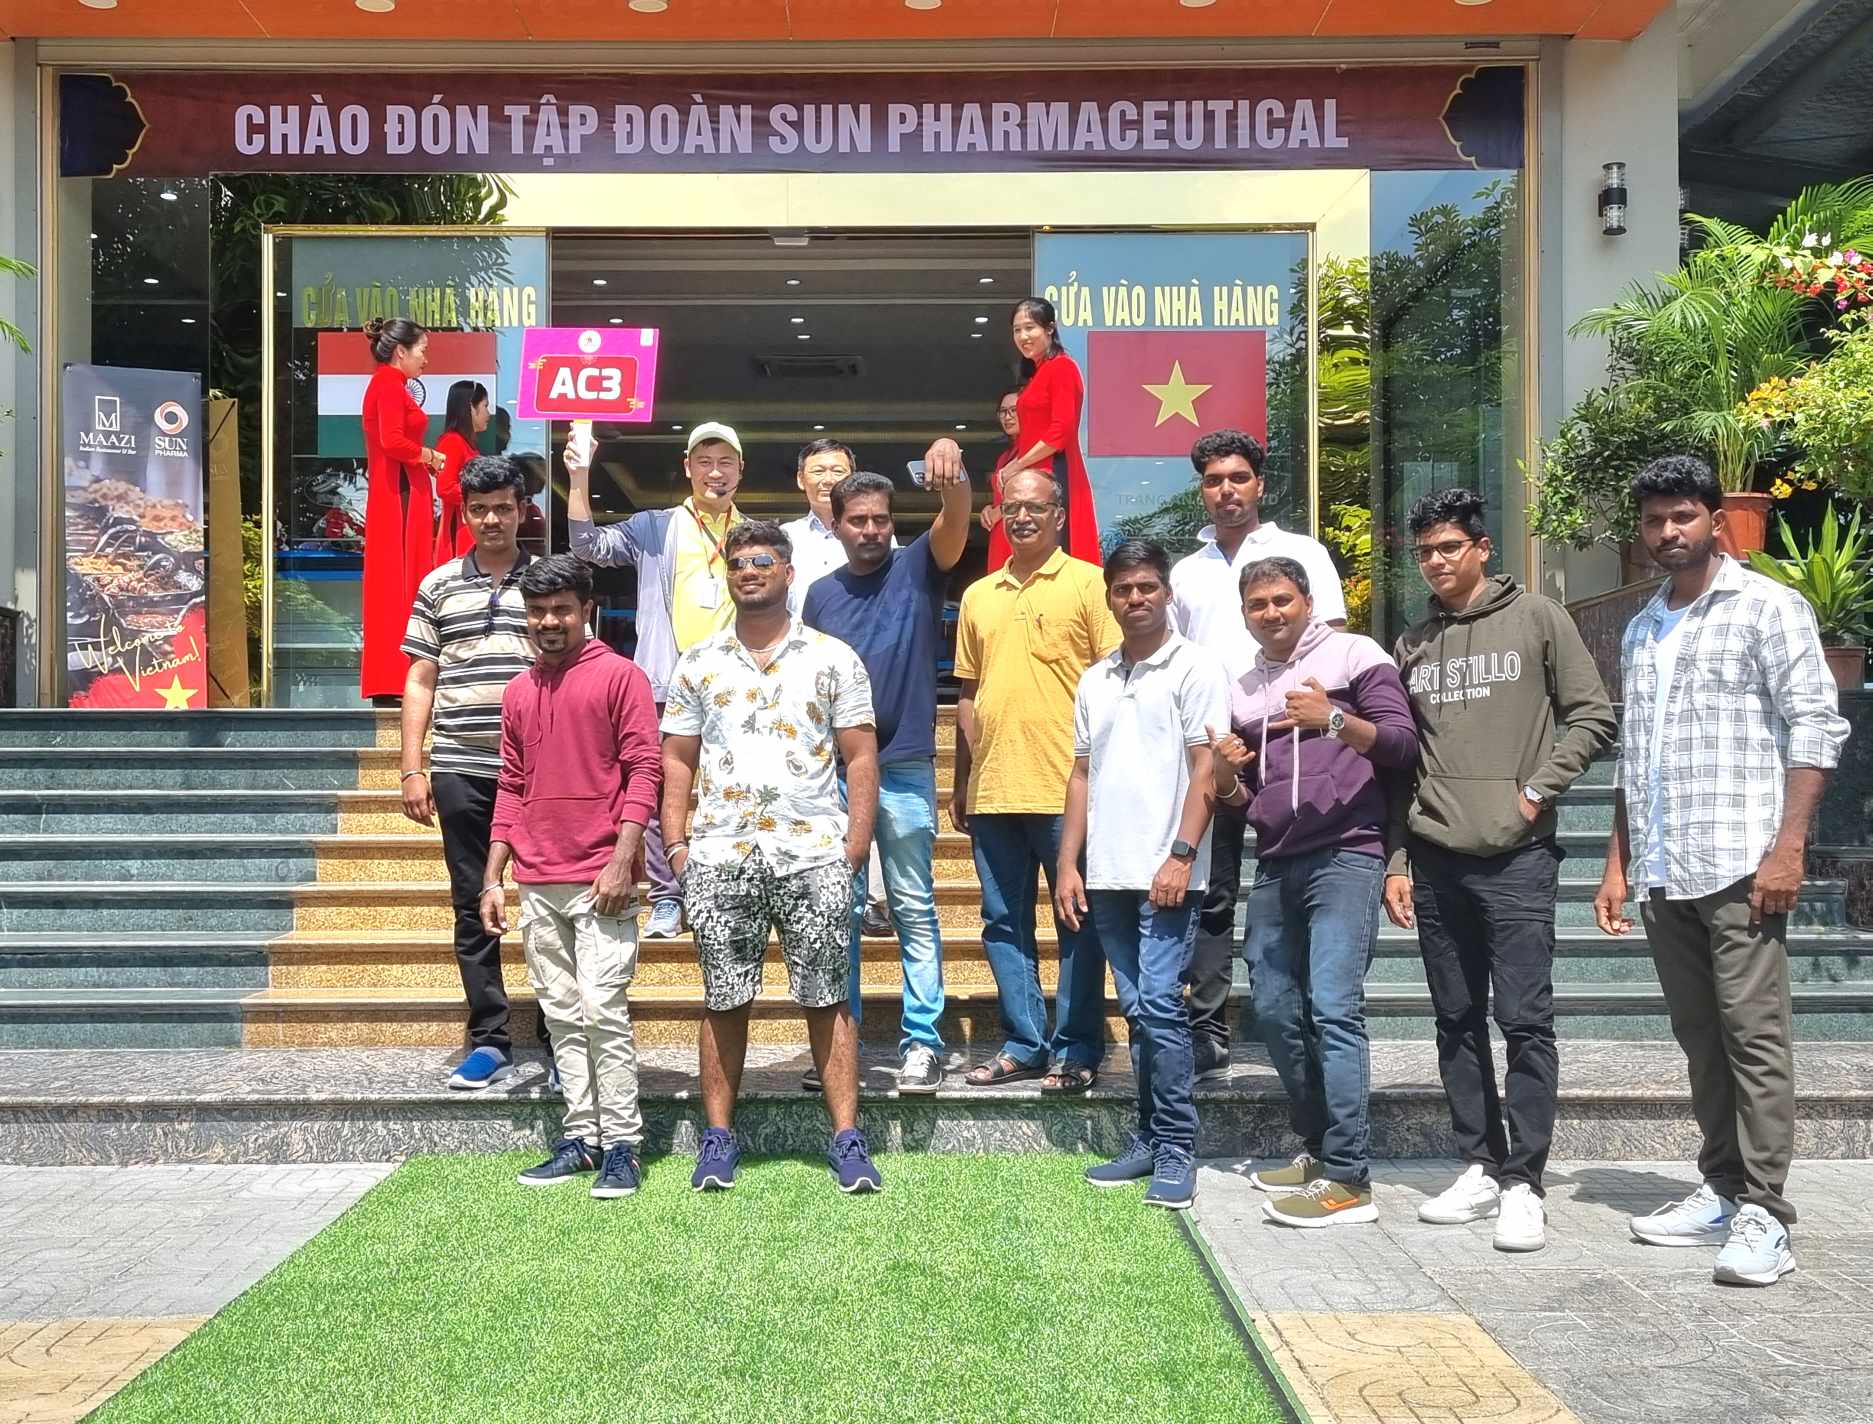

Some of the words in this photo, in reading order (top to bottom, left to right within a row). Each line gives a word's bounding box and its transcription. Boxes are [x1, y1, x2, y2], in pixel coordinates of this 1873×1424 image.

[234, 94, 370, 156] CHÀO
[384, 94, 490, 155] ĐÓN
[504, 94, 600, 166] TẬP
[613, 94, 753, 156] ĐOÀN
[768, 103, 872, 154] SUN
[887, 98, 1350, 154] PHARMACEUTICAL
[469, 280, 537, 327] HÀNG
[1102, 279, 1147, 327] VÀO
[1154, 278, 1203, 327] NHÀ
[1213, 279, 1280, 327] HÀNG
[549, 367, 622, 400] AC3
[80, 431, 136, 448] MAAZI
[155, 436, 189, 450] SUN
[1409, 661, 1441, 695] ART
[1446, 651, 1521, 688] STILLO
[1430, 686, 1491, 705] COLLECTION
